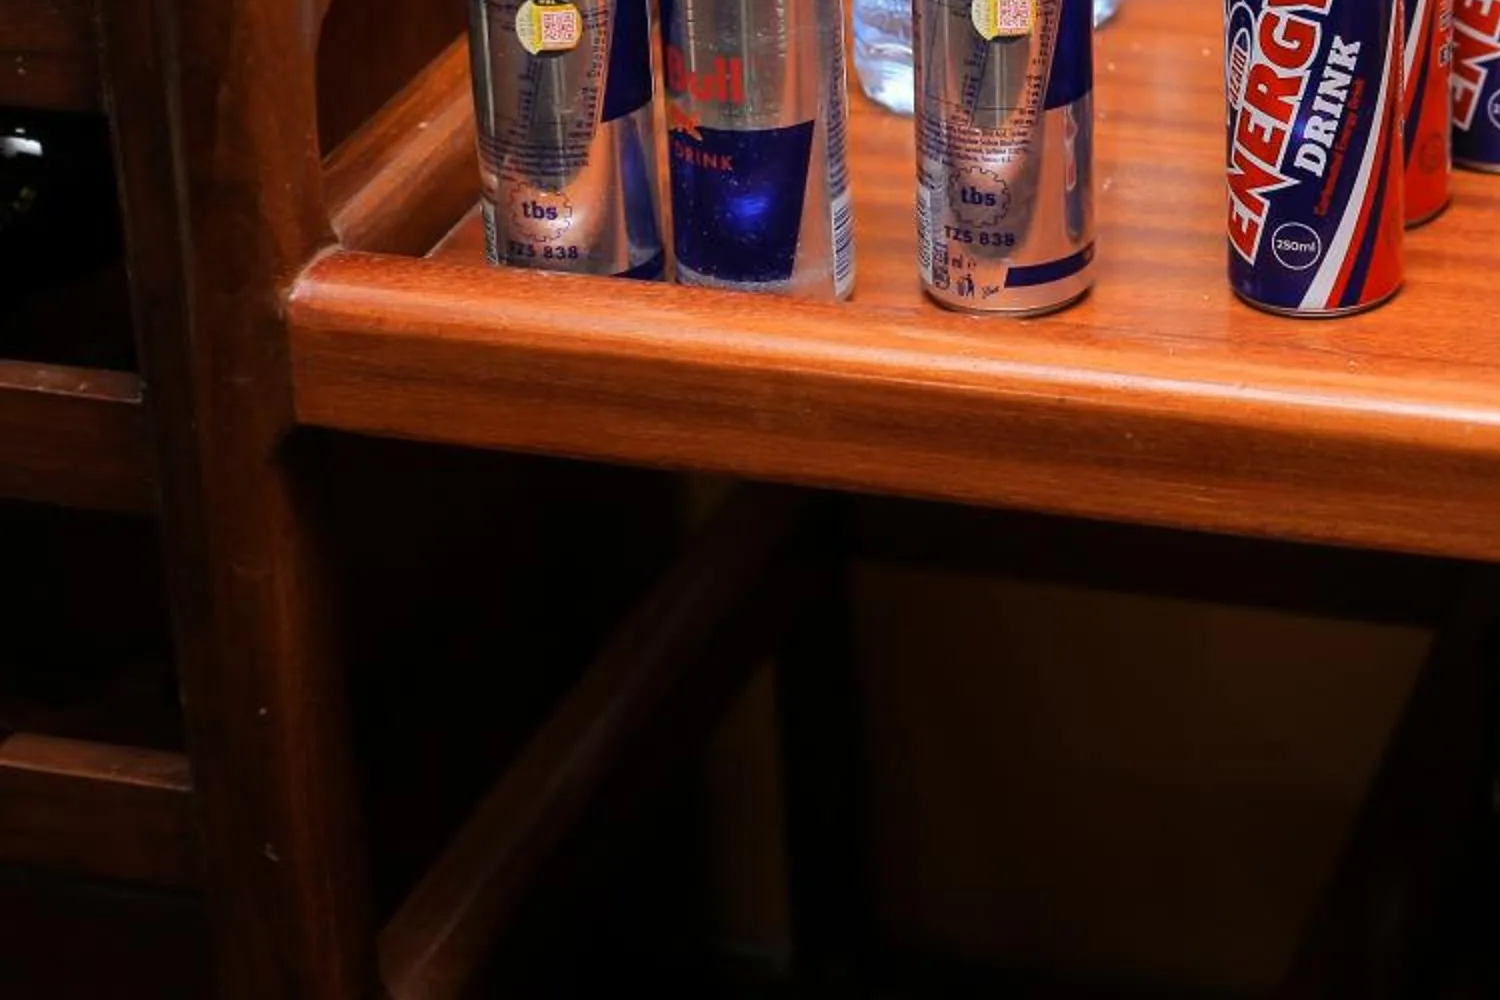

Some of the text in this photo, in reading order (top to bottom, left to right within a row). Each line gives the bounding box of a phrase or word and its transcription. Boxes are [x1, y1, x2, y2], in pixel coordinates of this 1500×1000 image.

[664, 45, 744, 105] Bull
[1294, 35, 1361, 178] DRINK
[674, 141, 734, 171] DRINK
[960, 185, 997, 207] tbs
[522, 201, 559, 221] tbs
[543, 244, 579, 260] 838
[1275, 237, 1317, 256] 250ml
